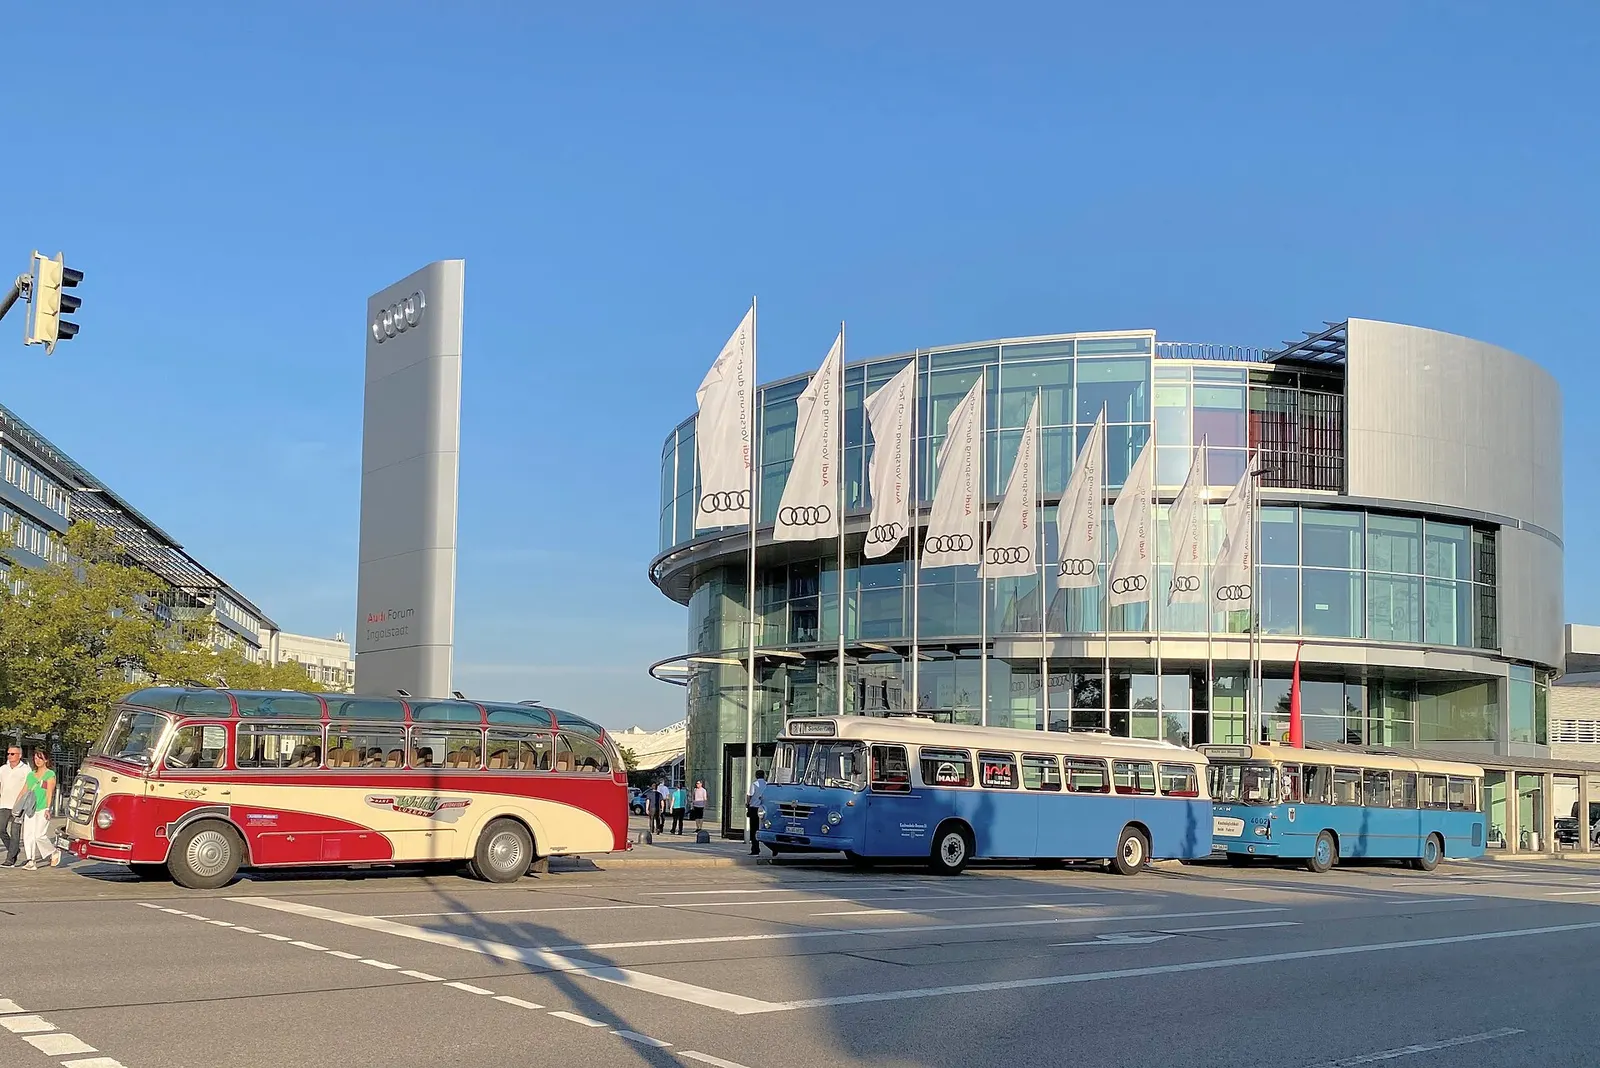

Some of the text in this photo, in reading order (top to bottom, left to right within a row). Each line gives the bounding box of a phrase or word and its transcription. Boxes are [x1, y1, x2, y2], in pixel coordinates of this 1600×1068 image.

[367, 608, 414, 623] Audi Forum
[366, 626, 409, 642] Ingolstadt
[398, 807, 428, 816] LUZERN
